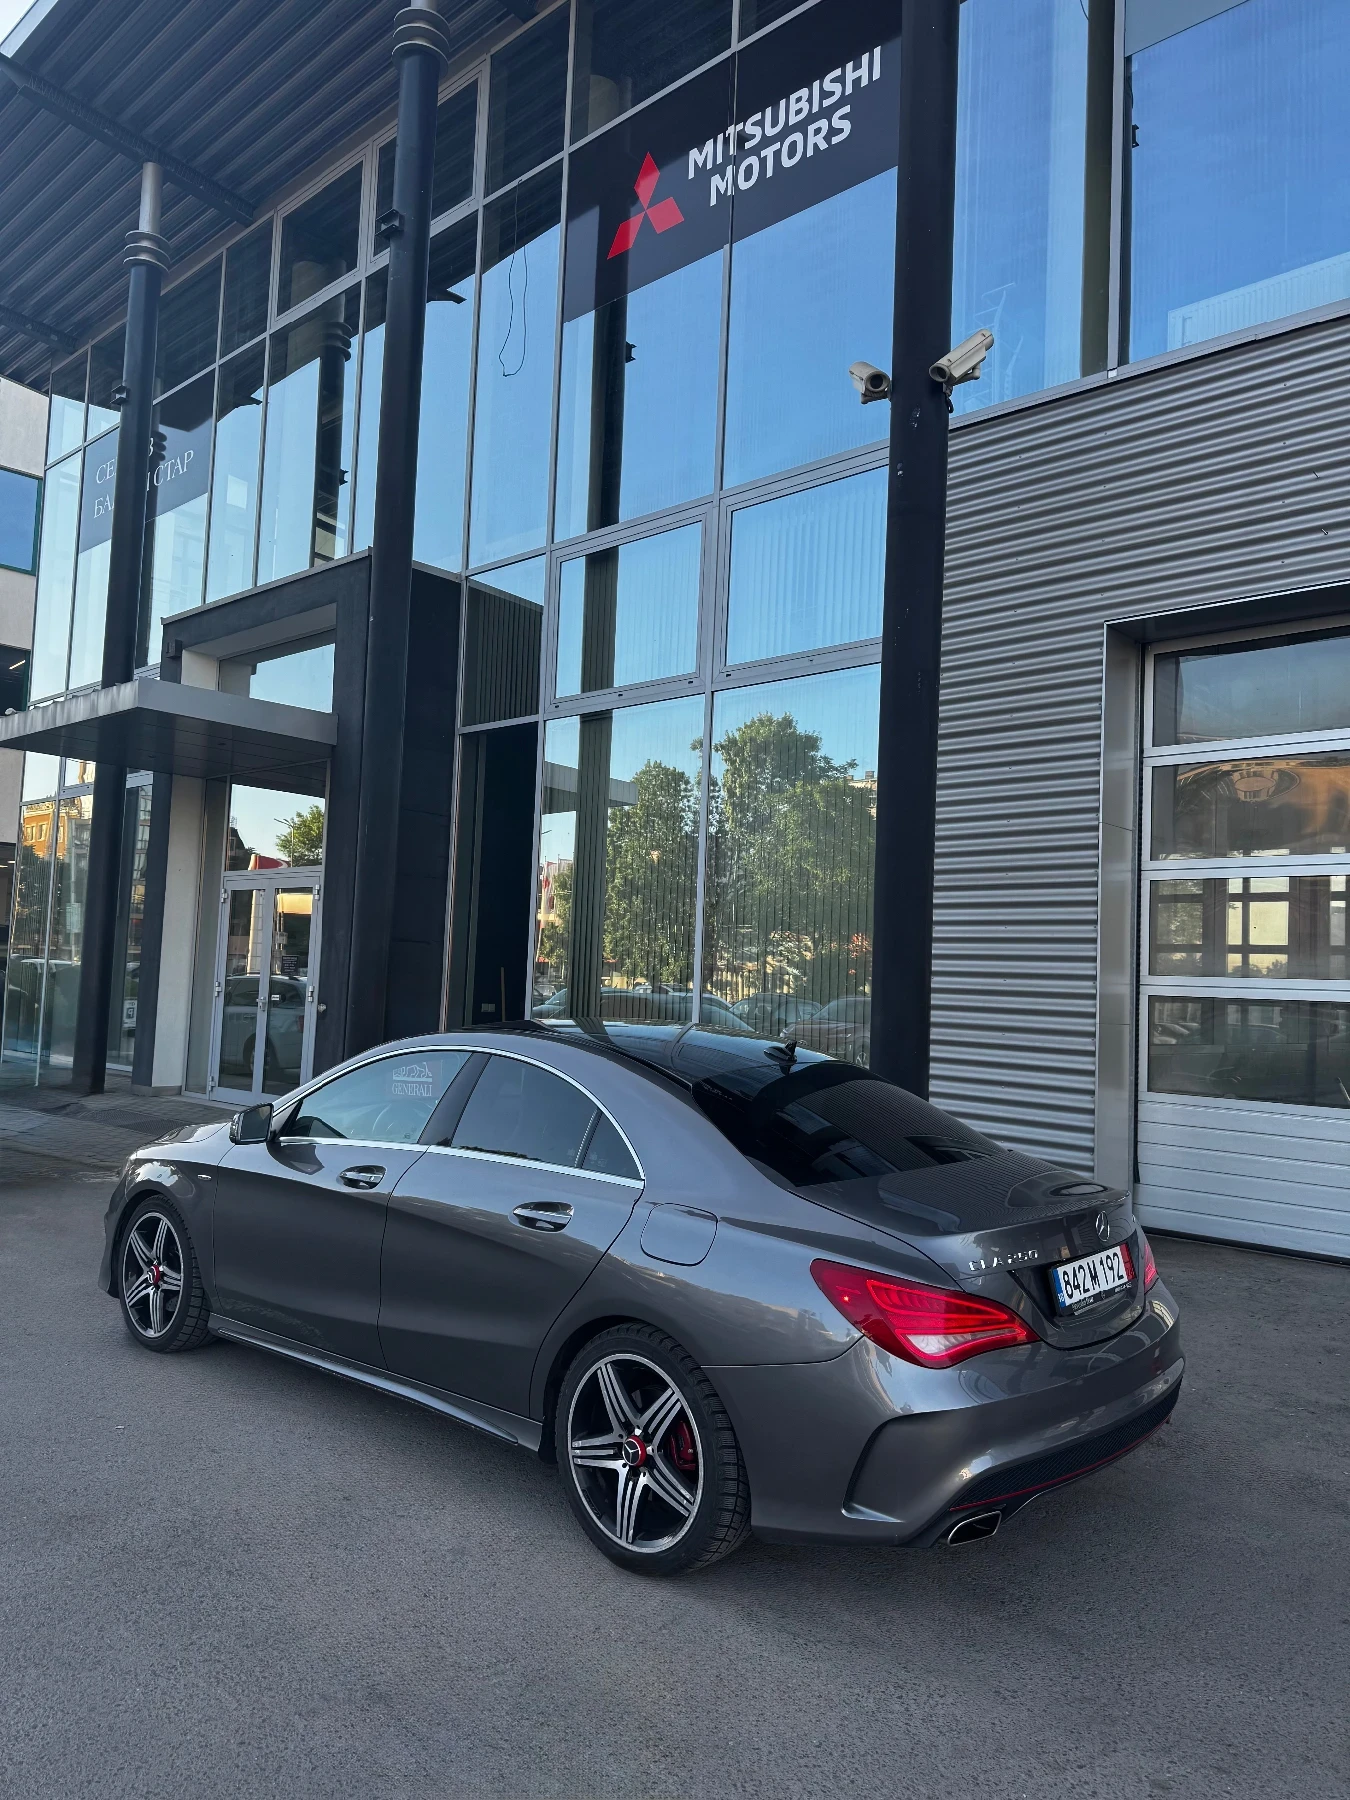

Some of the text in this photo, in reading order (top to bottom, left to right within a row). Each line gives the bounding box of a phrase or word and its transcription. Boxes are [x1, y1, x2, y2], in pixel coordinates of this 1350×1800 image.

[688, 46, 882, 180] MITSUBISHI
[711, 105, 851, 207] MOTORS
[153, 449, 194, 487] СТАР
[392, 1082, 433, 1097] GENERALI
